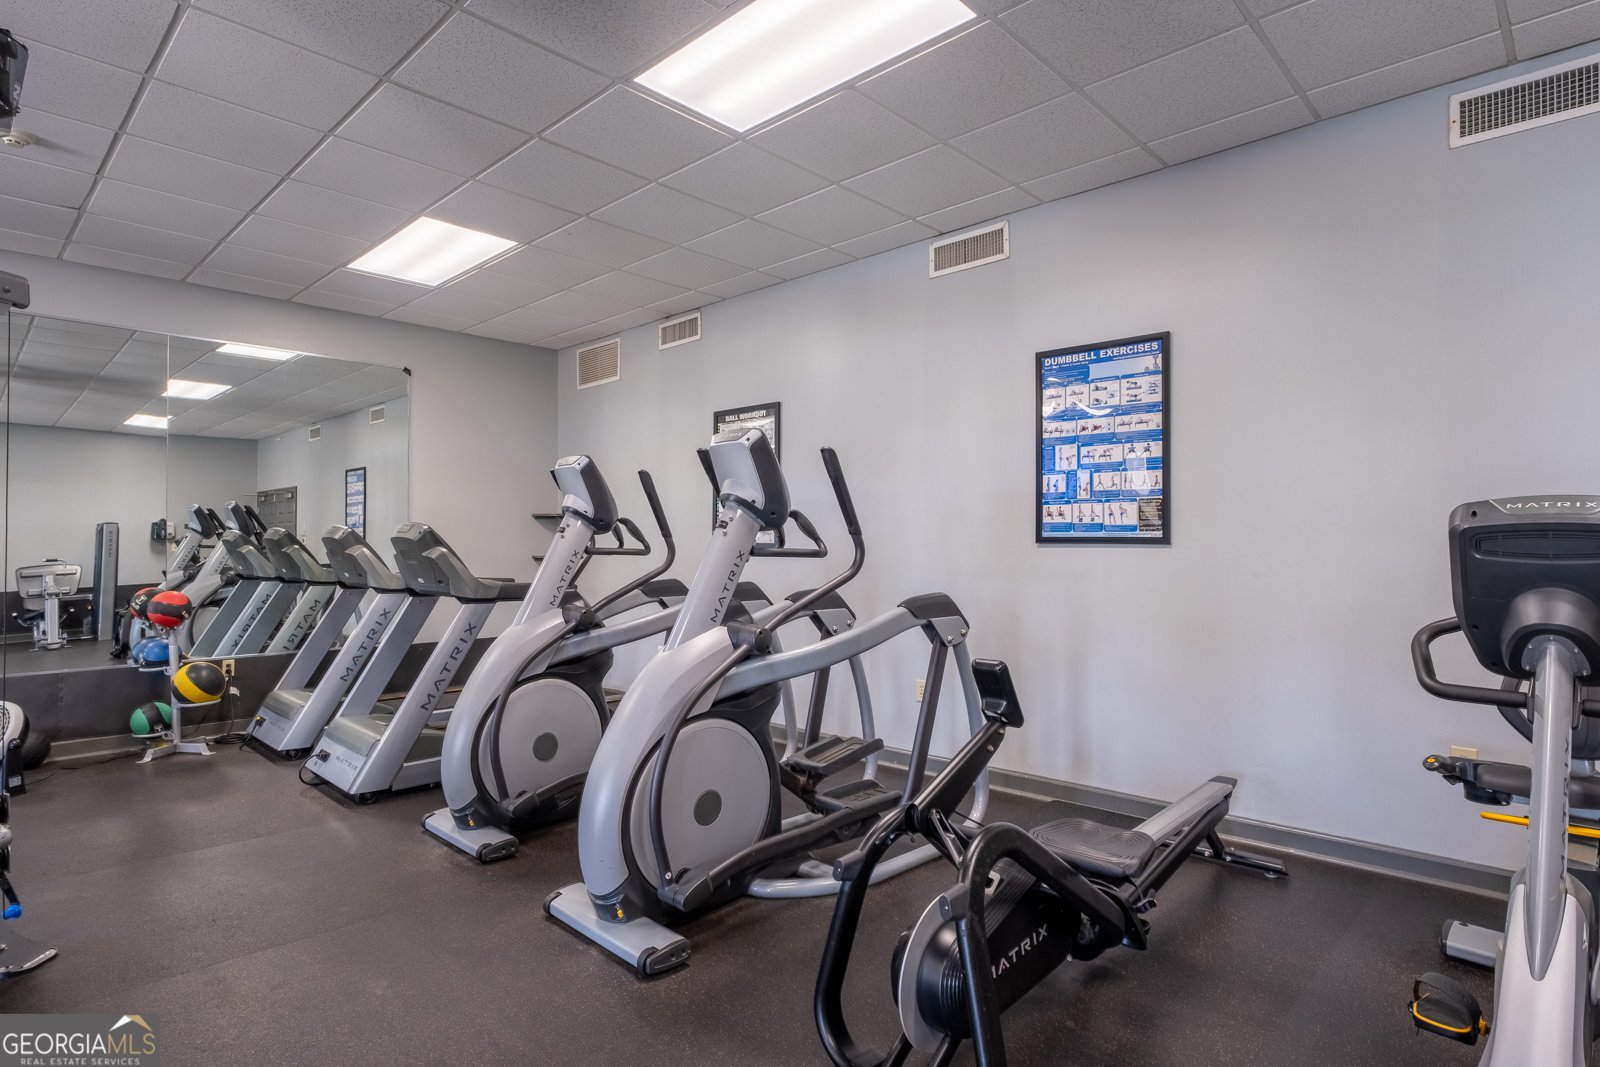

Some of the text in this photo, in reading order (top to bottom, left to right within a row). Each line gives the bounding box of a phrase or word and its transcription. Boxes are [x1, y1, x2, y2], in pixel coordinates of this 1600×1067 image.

[1044, 351, 1097, 366] DUMBBELL
[1100, 341, 1159, 358] EXERCISES
[725, 410, 767, 422] BALL WORKOUT
[1506, 500, 1600, 509] MATRIX
[550, 549, 580, 608] MATRIX
[711, 549, 746, 623] MATRIX
[340, 607, 392, 683] MATRIX
[420, 621, 478, 712] MATRIX
[335, 755, 359, 771] MATRIX
